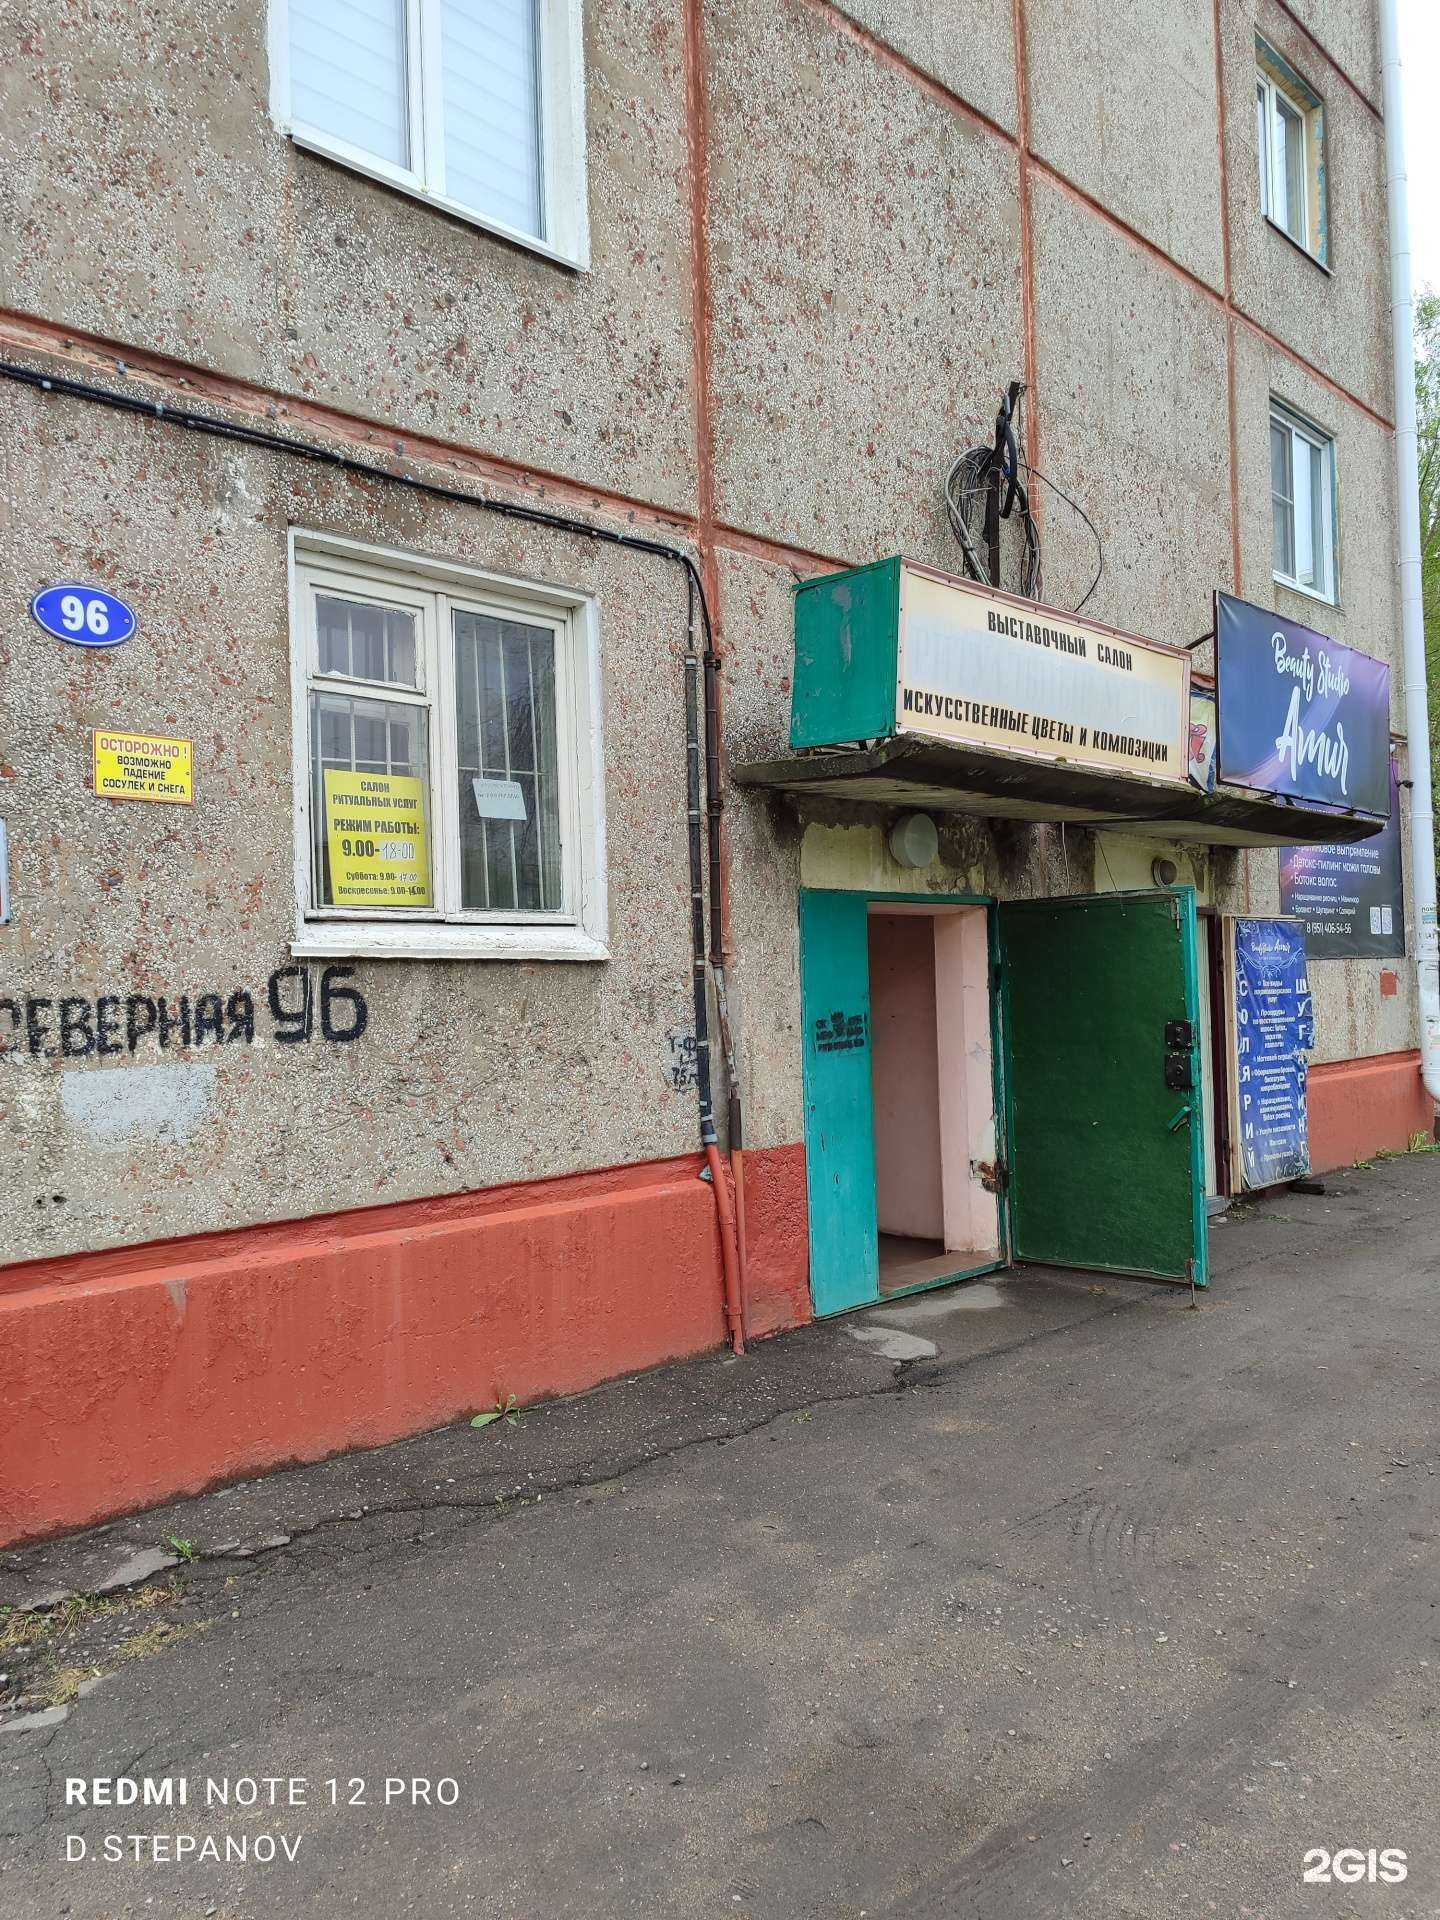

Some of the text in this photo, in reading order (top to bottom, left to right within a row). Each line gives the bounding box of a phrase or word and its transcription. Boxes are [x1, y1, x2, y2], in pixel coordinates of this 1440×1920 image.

[60, 594, 110, 635] 96
[987, 610, 1133, 671] ВЫСТАВОЧНЫЙ САЛОН
[1271, 631, 1350, 702] Beauty Studio
[903, 688, 1168, 762] ИСКУССТВЕННЫЕ ЦВЕТЫ И КОМПОЗИЦИИ
[100, 737, 180, 758] ОСТОРОЖНО
[1275, 686, 1349, 796] Amur
[117, 755, 171, 770] ВОЗМОЖНО
[123, 767, 166, 780] ПАДЕНИЕ
[102, 778, 185, 794] СОСУЛЕК И СНЕГА
[360, 781, 390, 793] САЛОН
[332, 794, 418, 809] РИТУАЛЬНЫХ УСЛУГ
[333, 818, 420, 835] РЕЖИМ РАБОТЫ:
[346, 871, 379, 881] Суббота:
[337, 886, 390, 896] Воскресенье:
[1306, 922, 1311, 934] 8
[268, 965, 368, 1044] 96
